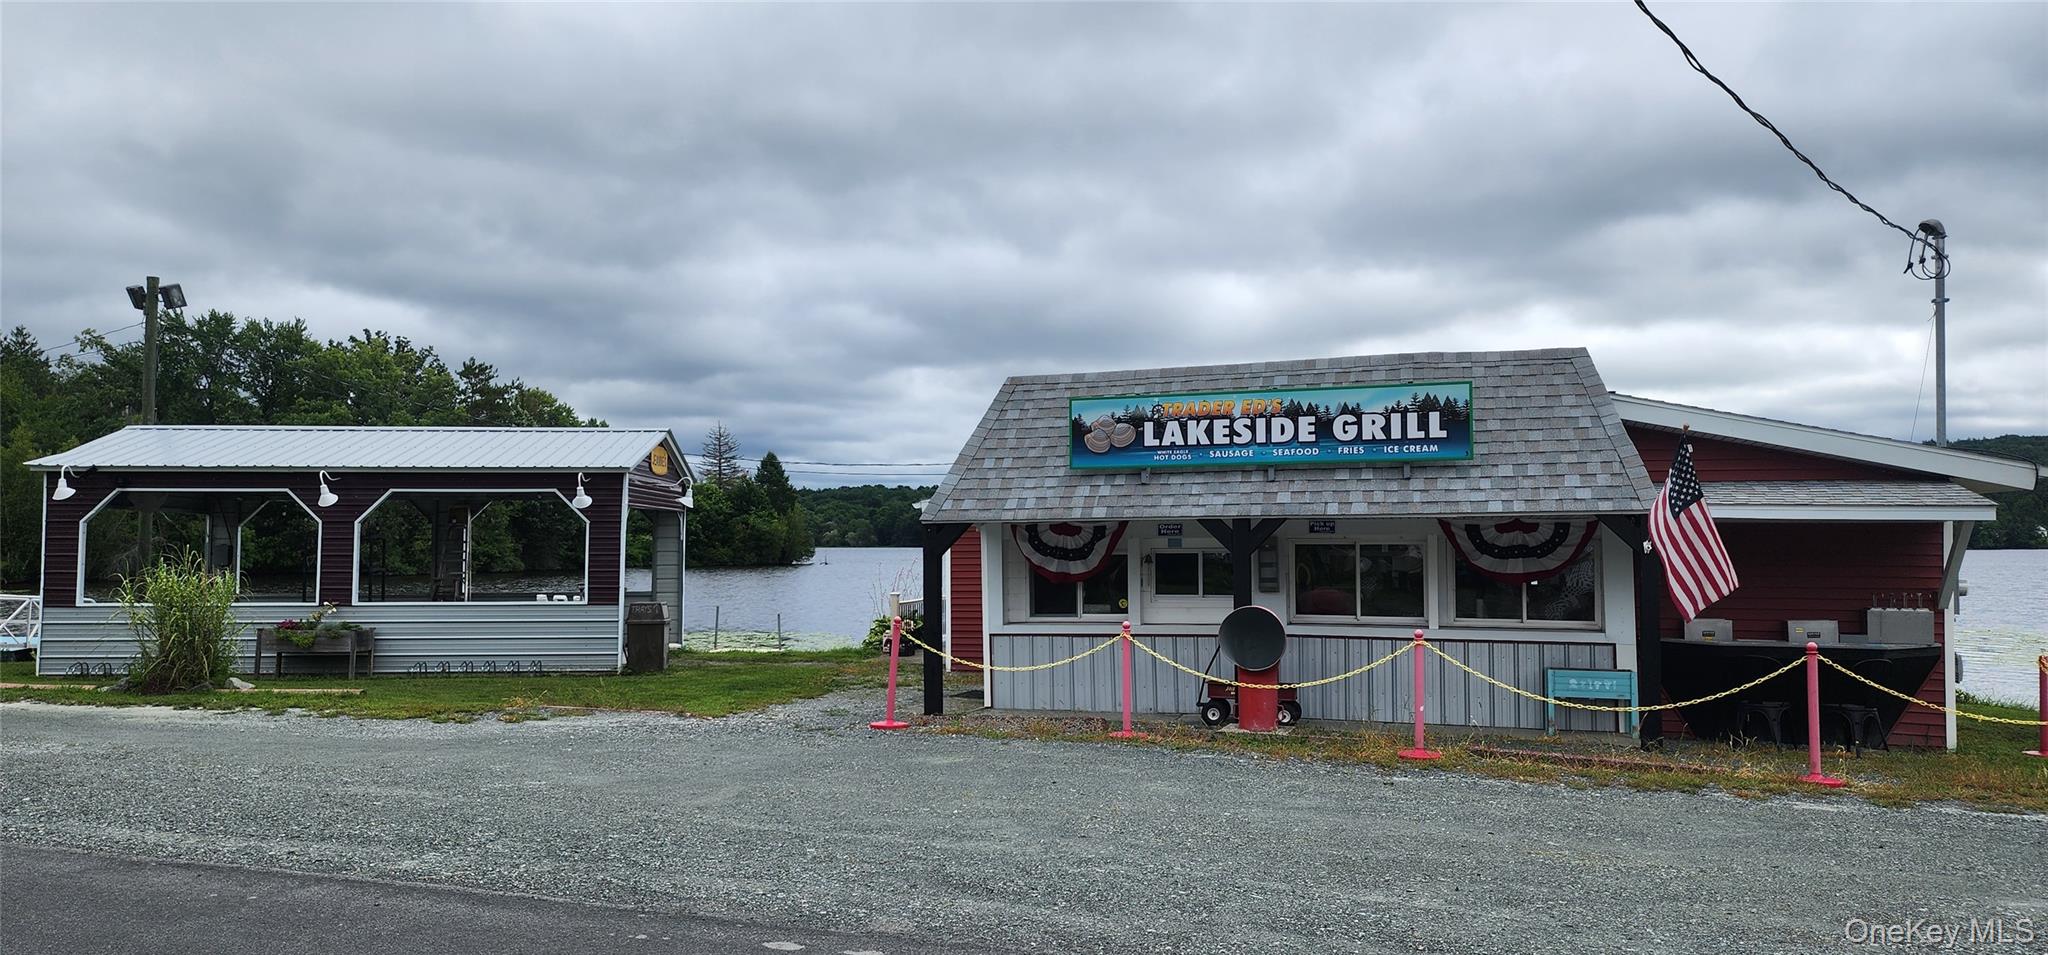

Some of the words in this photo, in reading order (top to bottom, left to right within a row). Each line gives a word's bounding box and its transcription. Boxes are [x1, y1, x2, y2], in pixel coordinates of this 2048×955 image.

[1162, 400, 1235, 417] TRADER
[1240, 397, 1282, 416] ED'S
[1143, 416, 1316, 447] LAKESIDE
[1332, 411, 1448, 442] GRILL
[1209, 449, 1254, 458] SAUSAGE
[1272, 447, 1319, 456] SEAFOOD
[1338, 446, 1365, 455] FRIES
[1383, 445, 1400, 454] ICE
[1403, 444, 1439, 453] CREAM
